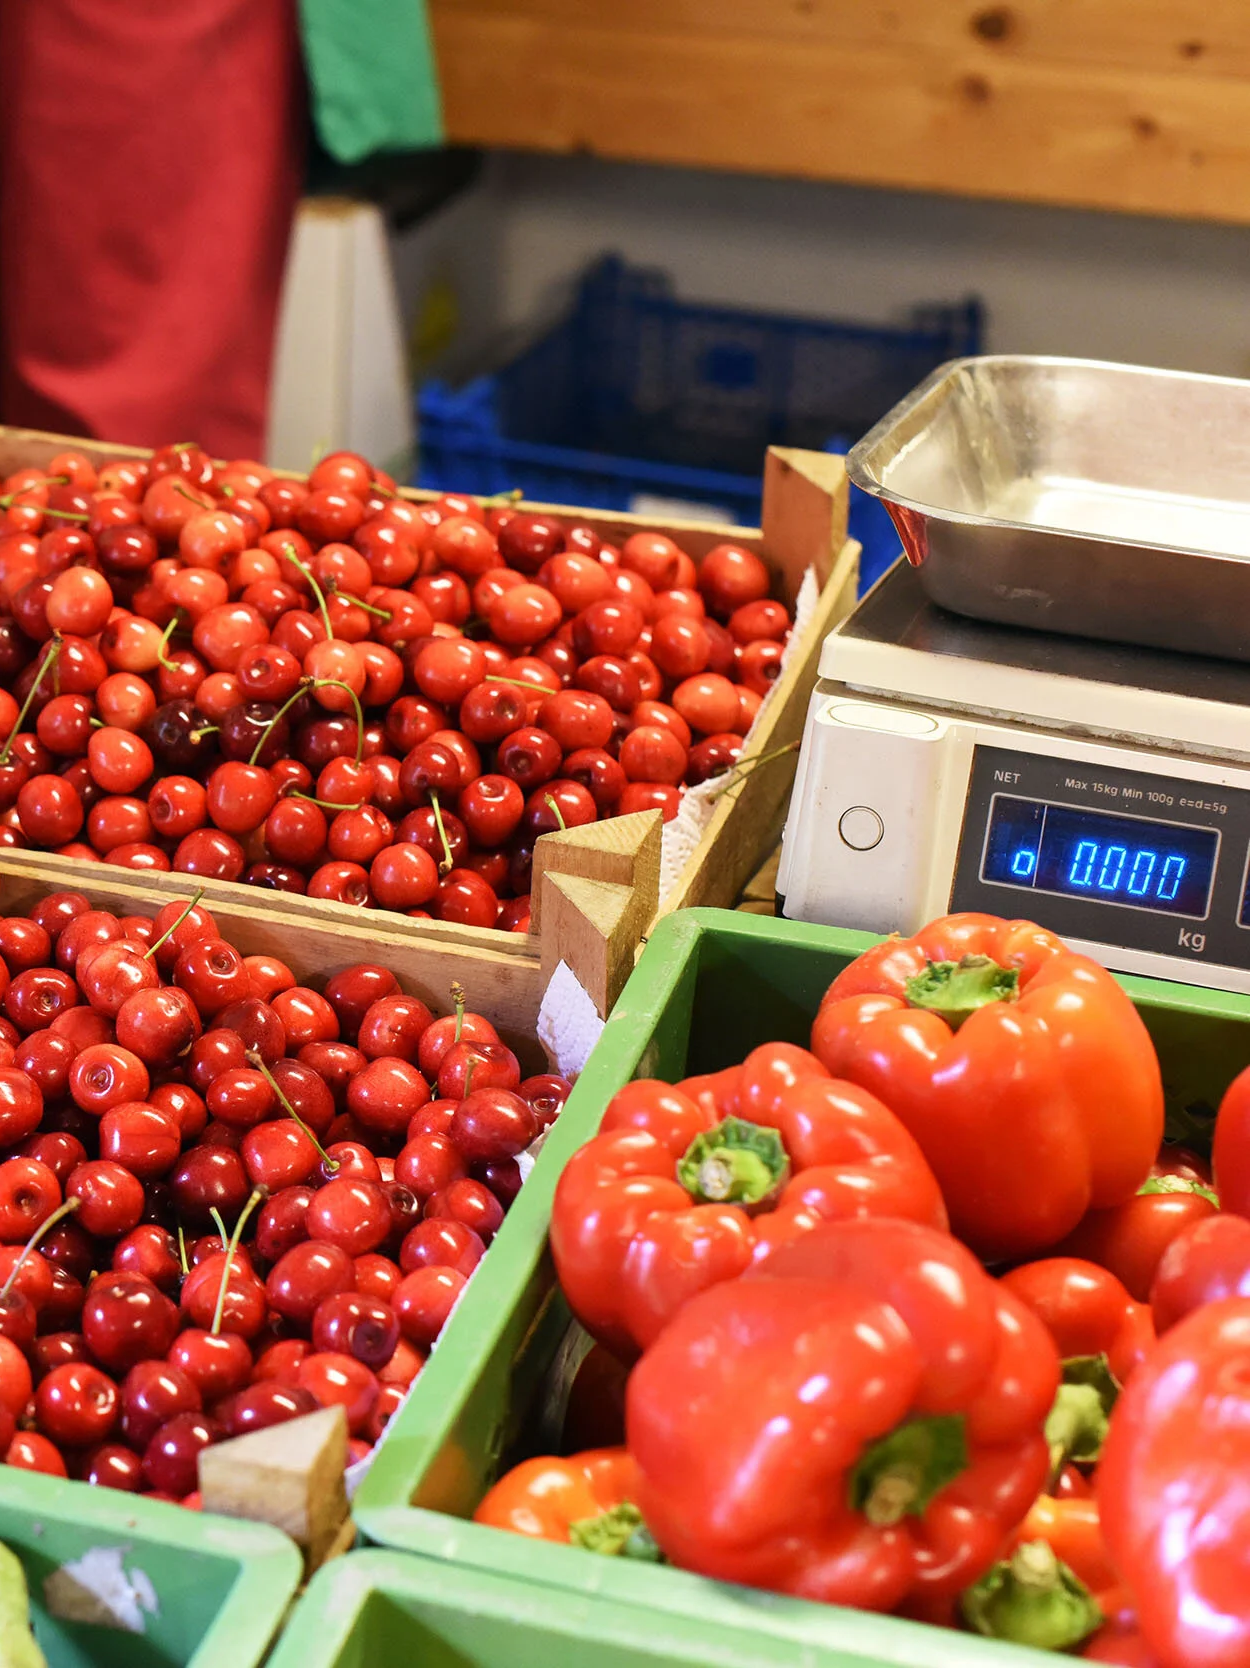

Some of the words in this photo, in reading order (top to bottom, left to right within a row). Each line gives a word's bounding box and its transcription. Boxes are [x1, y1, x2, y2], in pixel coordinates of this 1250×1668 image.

[993, 769, 1022, 785] NET
[1064, 777, 1088, 791] Max
[1091, 782, 1119, 797] 15kg
[1121, 787, 1144, 800] Min
[1146, 791, 1174, 806] 100g
[1179, 797, 1229, 815] e=d=5g
[1069, 841, 1186, 900] 0.000
[1177, 927, 1207, 953] kg
